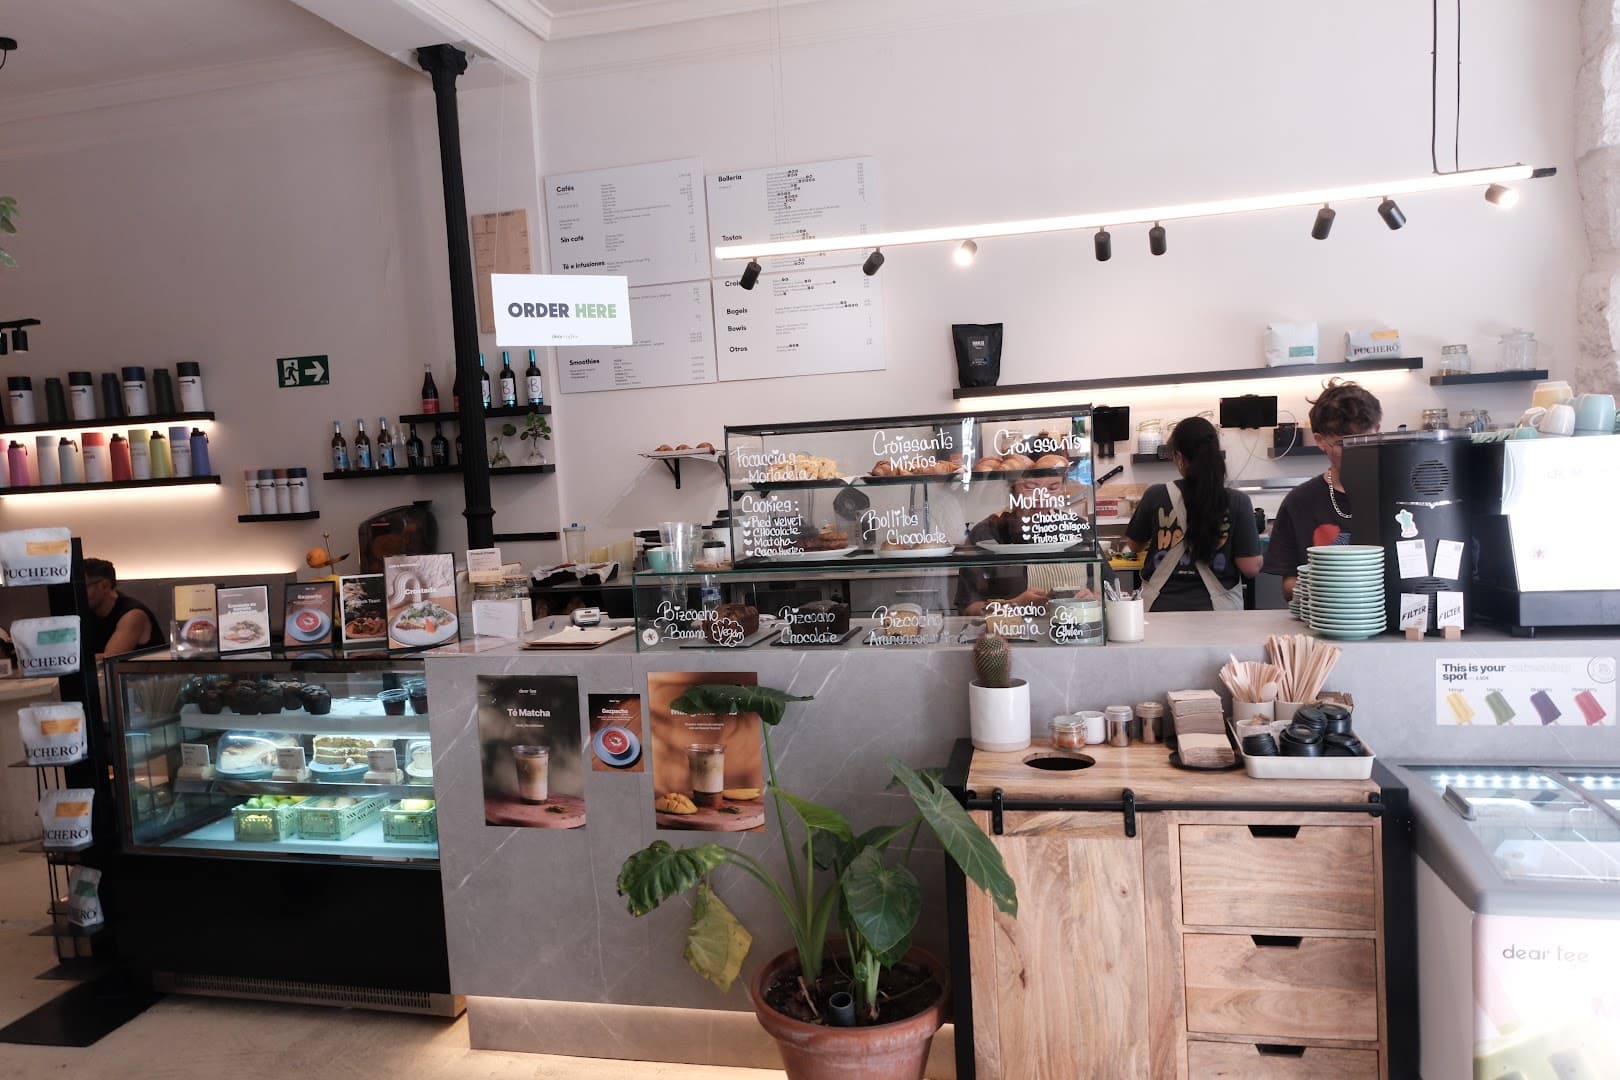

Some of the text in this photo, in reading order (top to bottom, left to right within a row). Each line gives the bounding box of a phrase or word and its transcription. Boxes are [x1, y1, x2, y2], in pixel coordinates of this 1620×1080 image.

[508, 302, 617, 319] ORDER HERE
[726, 307, 748, 316] Bagels
[569, 358, 600, 366] Smoothies
[872, 428, 953, 456] Croissants
[994, 428, 1082, 456] Croissants
[1009, 487, 1071, 510] Muffins:
[654, 600, 719, 628] Bizcocho
[776, 605, 836, 627] Bizcocho
[979, 600, 1046, 621] Bizcocho
[717, 626, 744, 640] Vegan
[781, 627, 840, 644] Chocolate
[1442, 664, 1467, 672] This
[1468, 664, 1478, 672] is
[1480, 665, 1506, 674] your
[1442, 672, 1468, 682] spot
[507, 708, 550, 717] Té Matcha
[1502, 944, 1550, 960] dear
